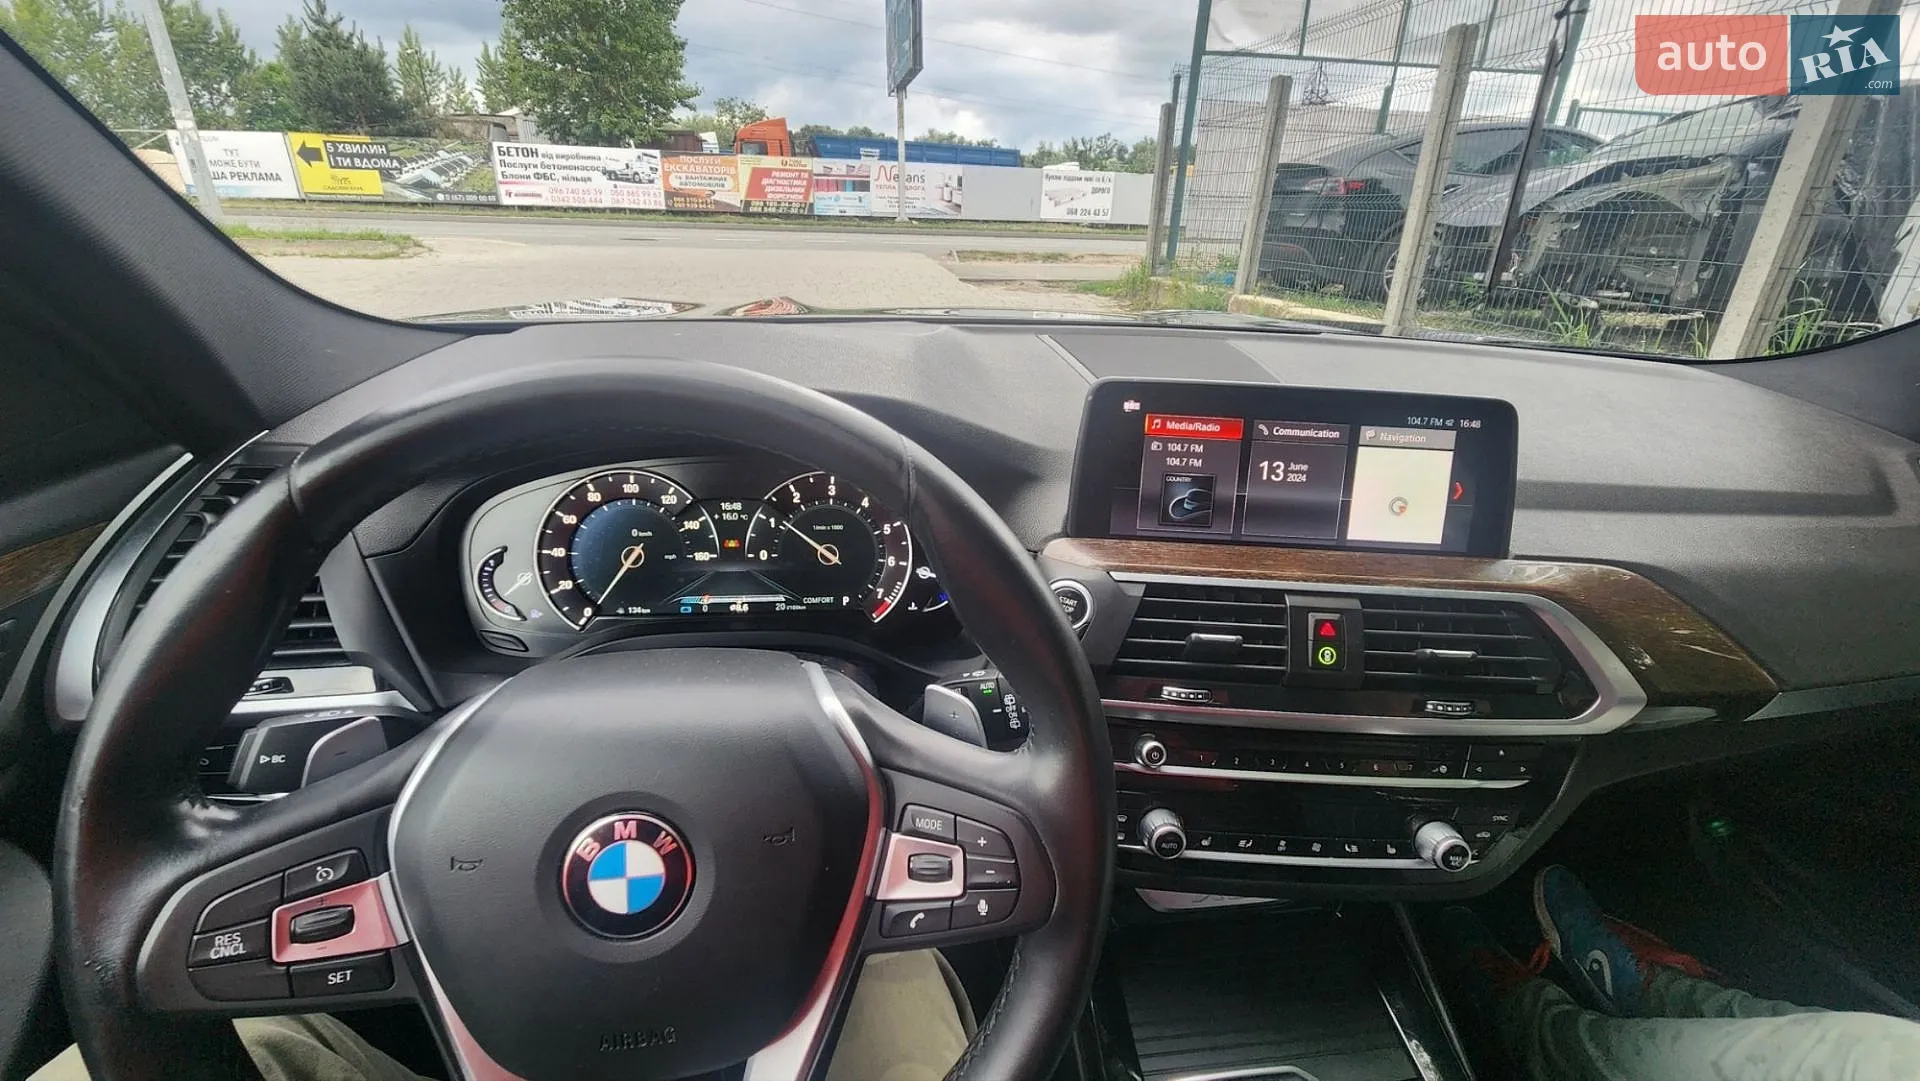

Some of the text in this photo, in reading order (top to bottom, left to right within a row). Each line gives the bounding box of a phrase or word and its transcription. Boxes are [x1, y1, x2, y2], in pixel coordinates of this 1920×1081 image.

[223, 148, 239, 157] ТУТ
[326, 142, 387, 154] 5 ХВИЛИН
[497, 146, 539, 158] БЕТОН
[209, 159, 260, 169] МОЖЕ БУТИ
[336, 156, 352, 167] ТИ
[354, 157, 401, 169] ВДОМА
[500, 159, 538, 171] Послуги
[680, 156, 720, 164] ПОСЛУГИ
[664, 163, 736, 174] ЕКСКАВАТОРІВ
[229, 172, 282, 182] РЕКЛАМА
[874, 165, 926, 184] Neans
[1166, 420, 1220, 432] Media/Radio
[1407, 416, 1481, 429] 104.7 FM 16:48
[1273, 426, 1340, 438] Communication
[1380, 432, 1427, 443] Navigation
[1167, 443, 1203, 453] 104.7 FM
[1166, 457, 1202, 467] 104.7 FM
[1288, 463, 1308, 471] June
[1259, 461, 1285, 481] 13
[1287, 473, 1307, 482] 2024
[622, 484, 639, 493] 100
[828, 486, 836, 496] 3
[587, 492, 601, 502] 80
[661, 495, 677, 505] 120
[793, 492, 800, 503] 2
[861, 497, 869, 508] 4
[563, 515, 577, 524] 60
[769, 517, 775, 527] 1
[684, 520, 699, 530] 140
[883, 524, 891, 534] 5
[631, 529, 638, 537] 0
[551, 547, 565, 557] 40
[694, 552, 710, 561] 160
[759, 550, 767, 560] 0
[887, 556, 895, 566] 6
[559, 581, 573, 589] 20
[877, 588, 884, 598] 7
[843, 597, 849, 605] P
[1059, 596, 1077, 607] START
[583, 607, 592, 617] 0
[702, 603, 708, 612] 0
[980, 682, 995, 690] AUTO
[271, 755, 286, 763] BC
[916, 817, 943, 831] MODE
[577, 820, 678, 861] BMW
[215, 932, 241, 947] RES
[210, 943, 246, 959] CNCL
[328, 970, 352, 984] SET
[600, 1026, 676, 1052] AIRBAG
